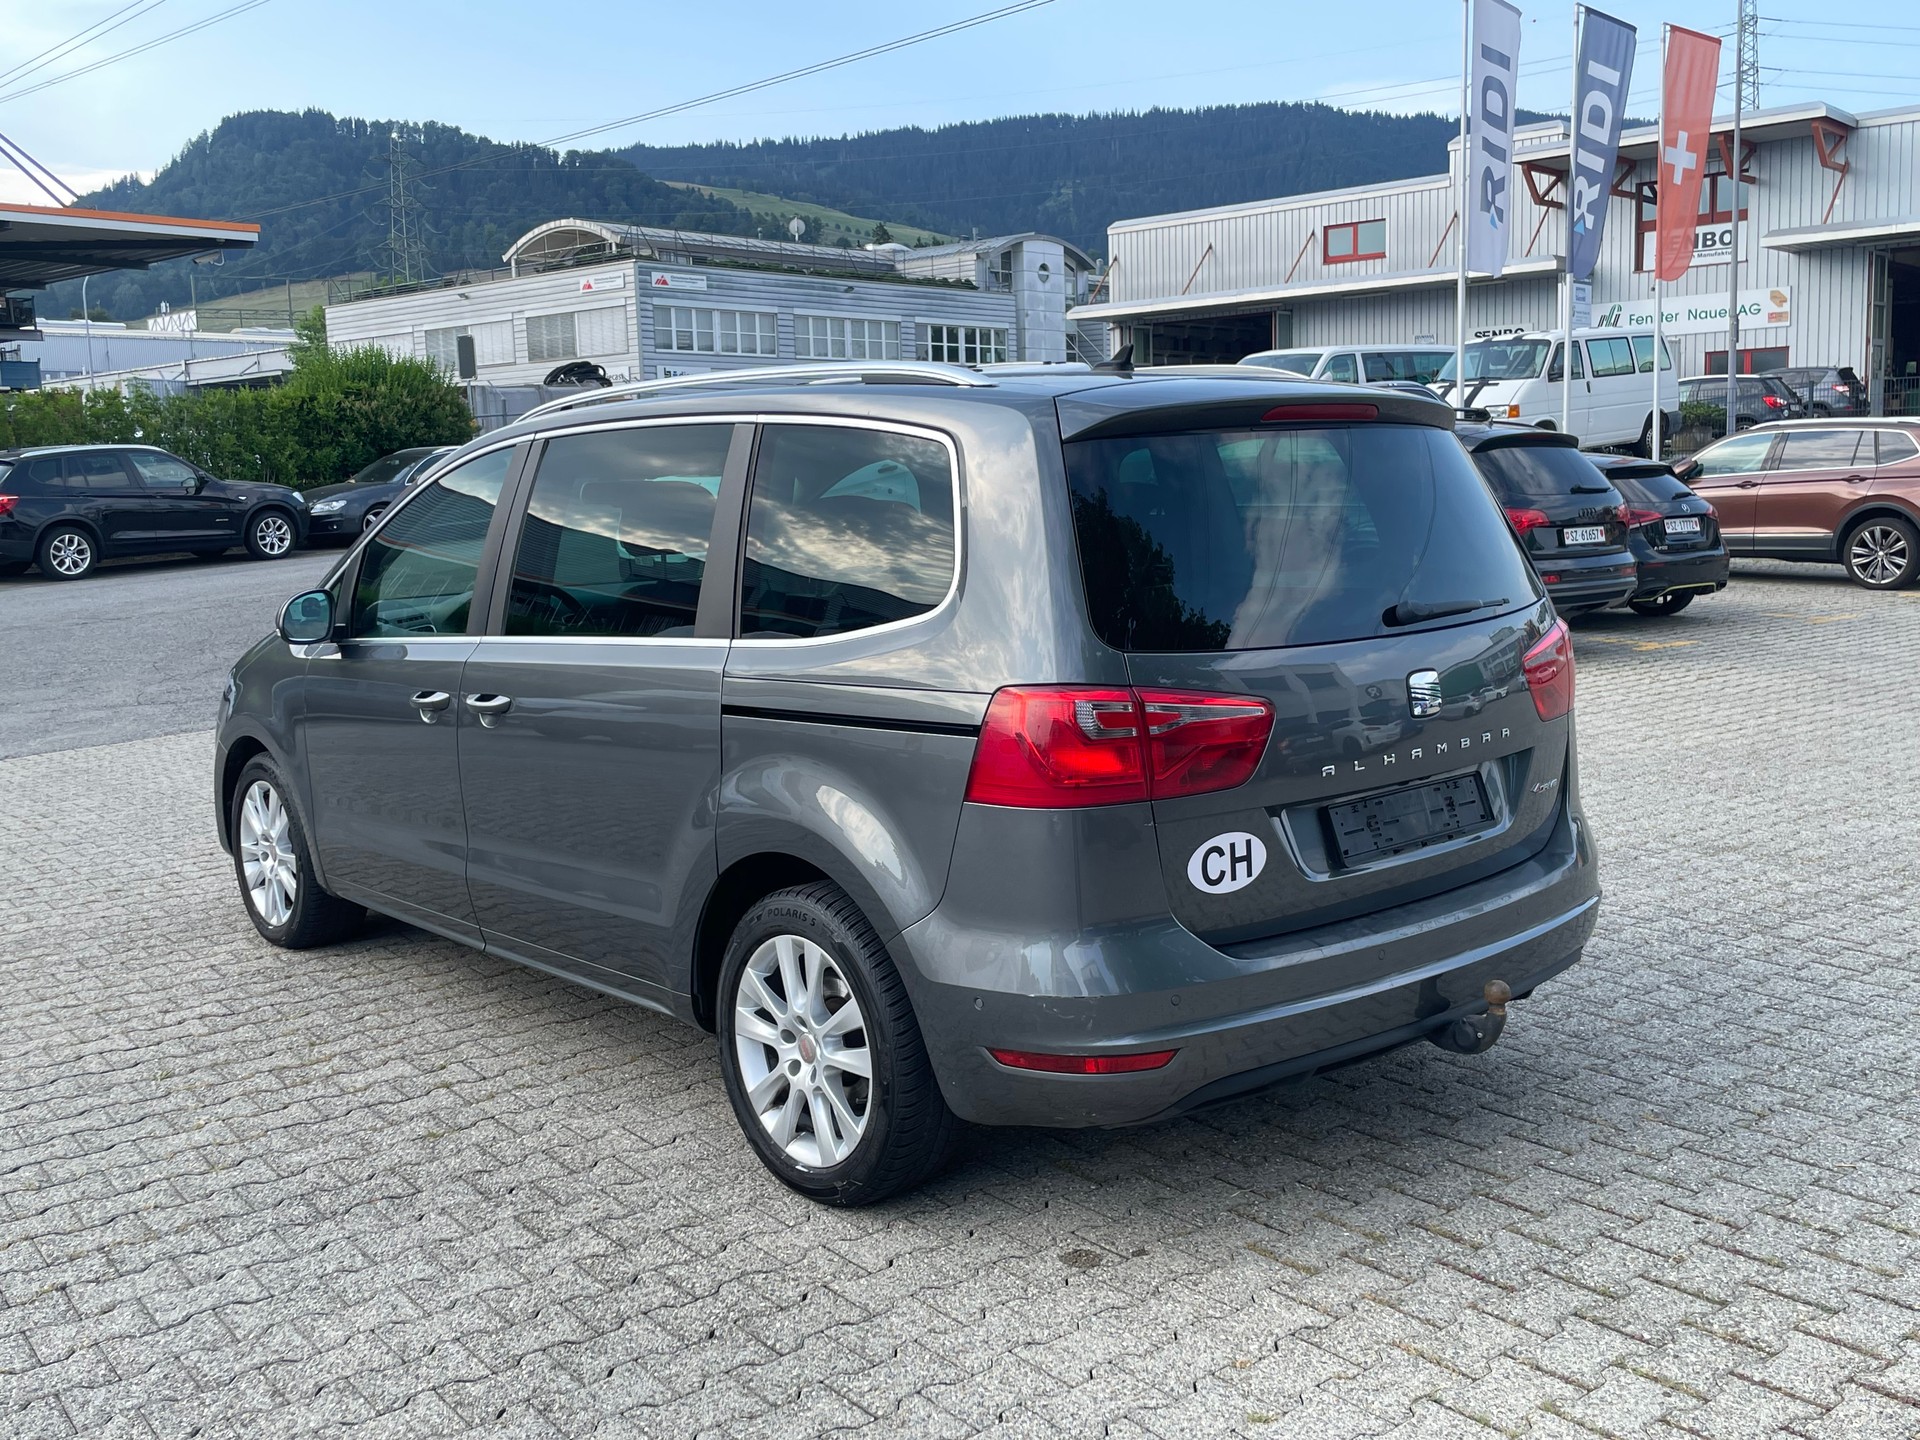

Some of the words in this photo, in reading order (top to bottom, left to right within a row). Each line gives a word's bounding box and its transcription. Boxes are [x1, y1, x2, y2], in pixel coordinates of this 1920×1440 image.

[1480, 43, 1510, 224] RIDI
[1574, 60, 1621, 230] RIDI
[1697, 251, 1732, 259] Manufaktu
[1629, 311, 1679, 326] Fenter
[1687, 308, 1731, 321] Naue
[1738, 302, 1761, 316] AG
[1321, 727, 1510, 777] ALHAMBRA
[1201, 838, 1253, 887] CH
[767, 907, 808, 922] POLARIS
[809, 917, 817, 927] 5
